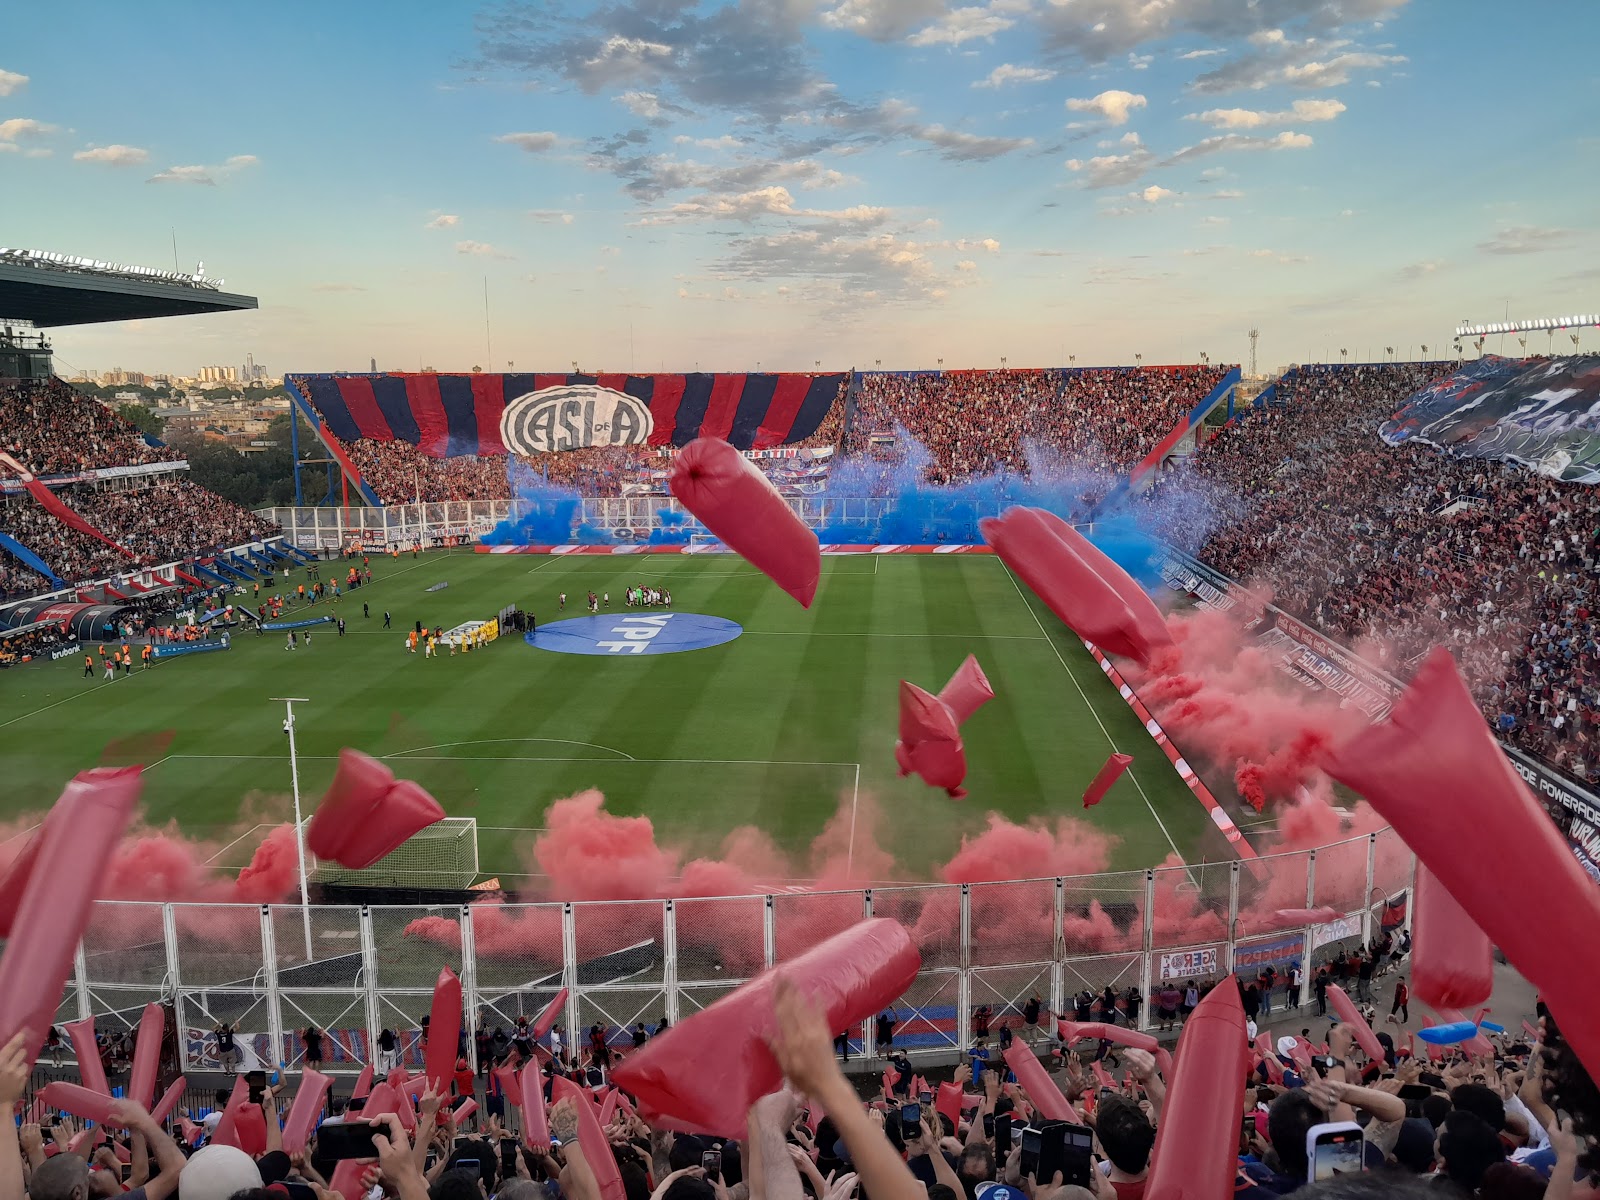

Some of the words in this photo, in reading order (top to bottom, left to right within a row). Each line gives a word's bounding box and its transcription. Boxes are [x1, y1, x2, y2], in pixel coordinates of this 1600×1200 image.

[444, 526, 472, 537] PALOMAR
[596, 613, 674, 653] YPF
[51, 643, 81, 660] brubank
[1327, 648, 1357, 675] POWERADE
[1540, 778, 1600, 828] POWERADE
[221, 1036, 227, 1044] 3
